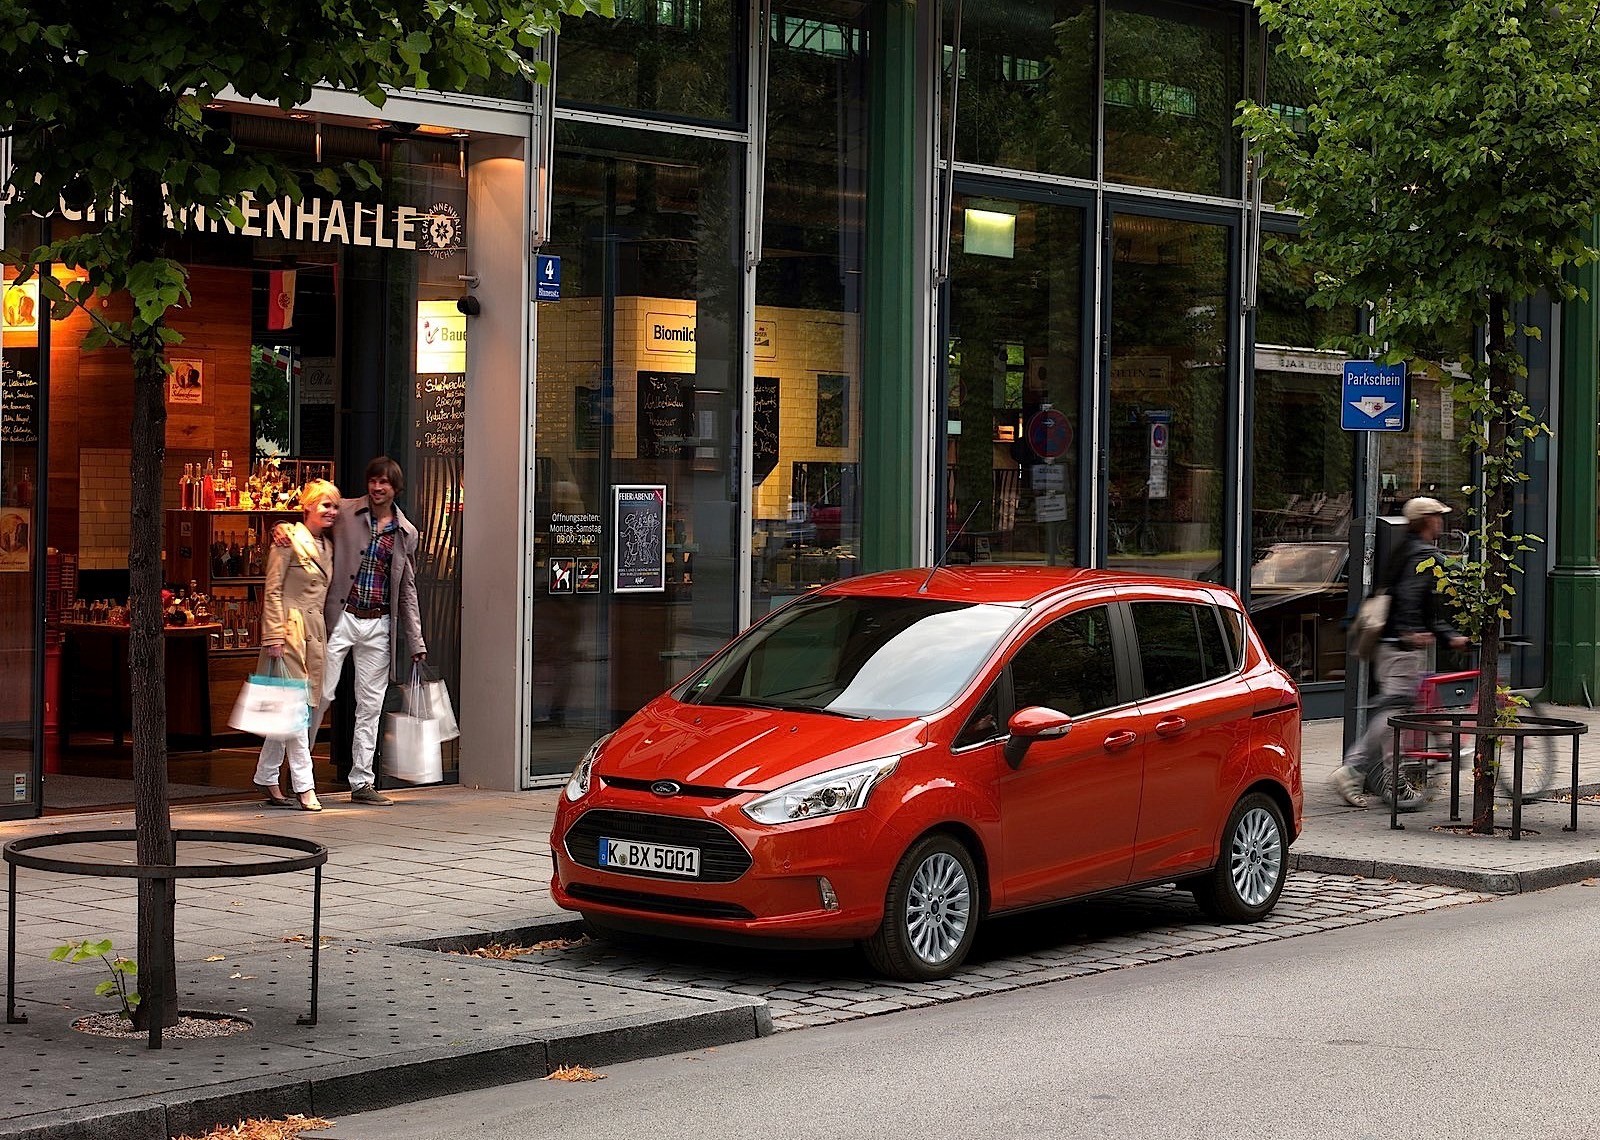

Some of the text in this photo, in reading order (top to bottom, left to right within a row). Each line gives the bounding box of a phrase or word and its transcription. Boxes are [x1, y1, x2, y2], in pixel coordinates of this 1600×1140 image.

[545, 259, 554, 280] 4
[1347, 372, 1400, 386] Parkschein
[549, 524, 602, 534] Montag-Samstag
[608, 843, 618, 863] K
[629, 845, 651, 868] BX
[654, 847, 696, 873] 5001
